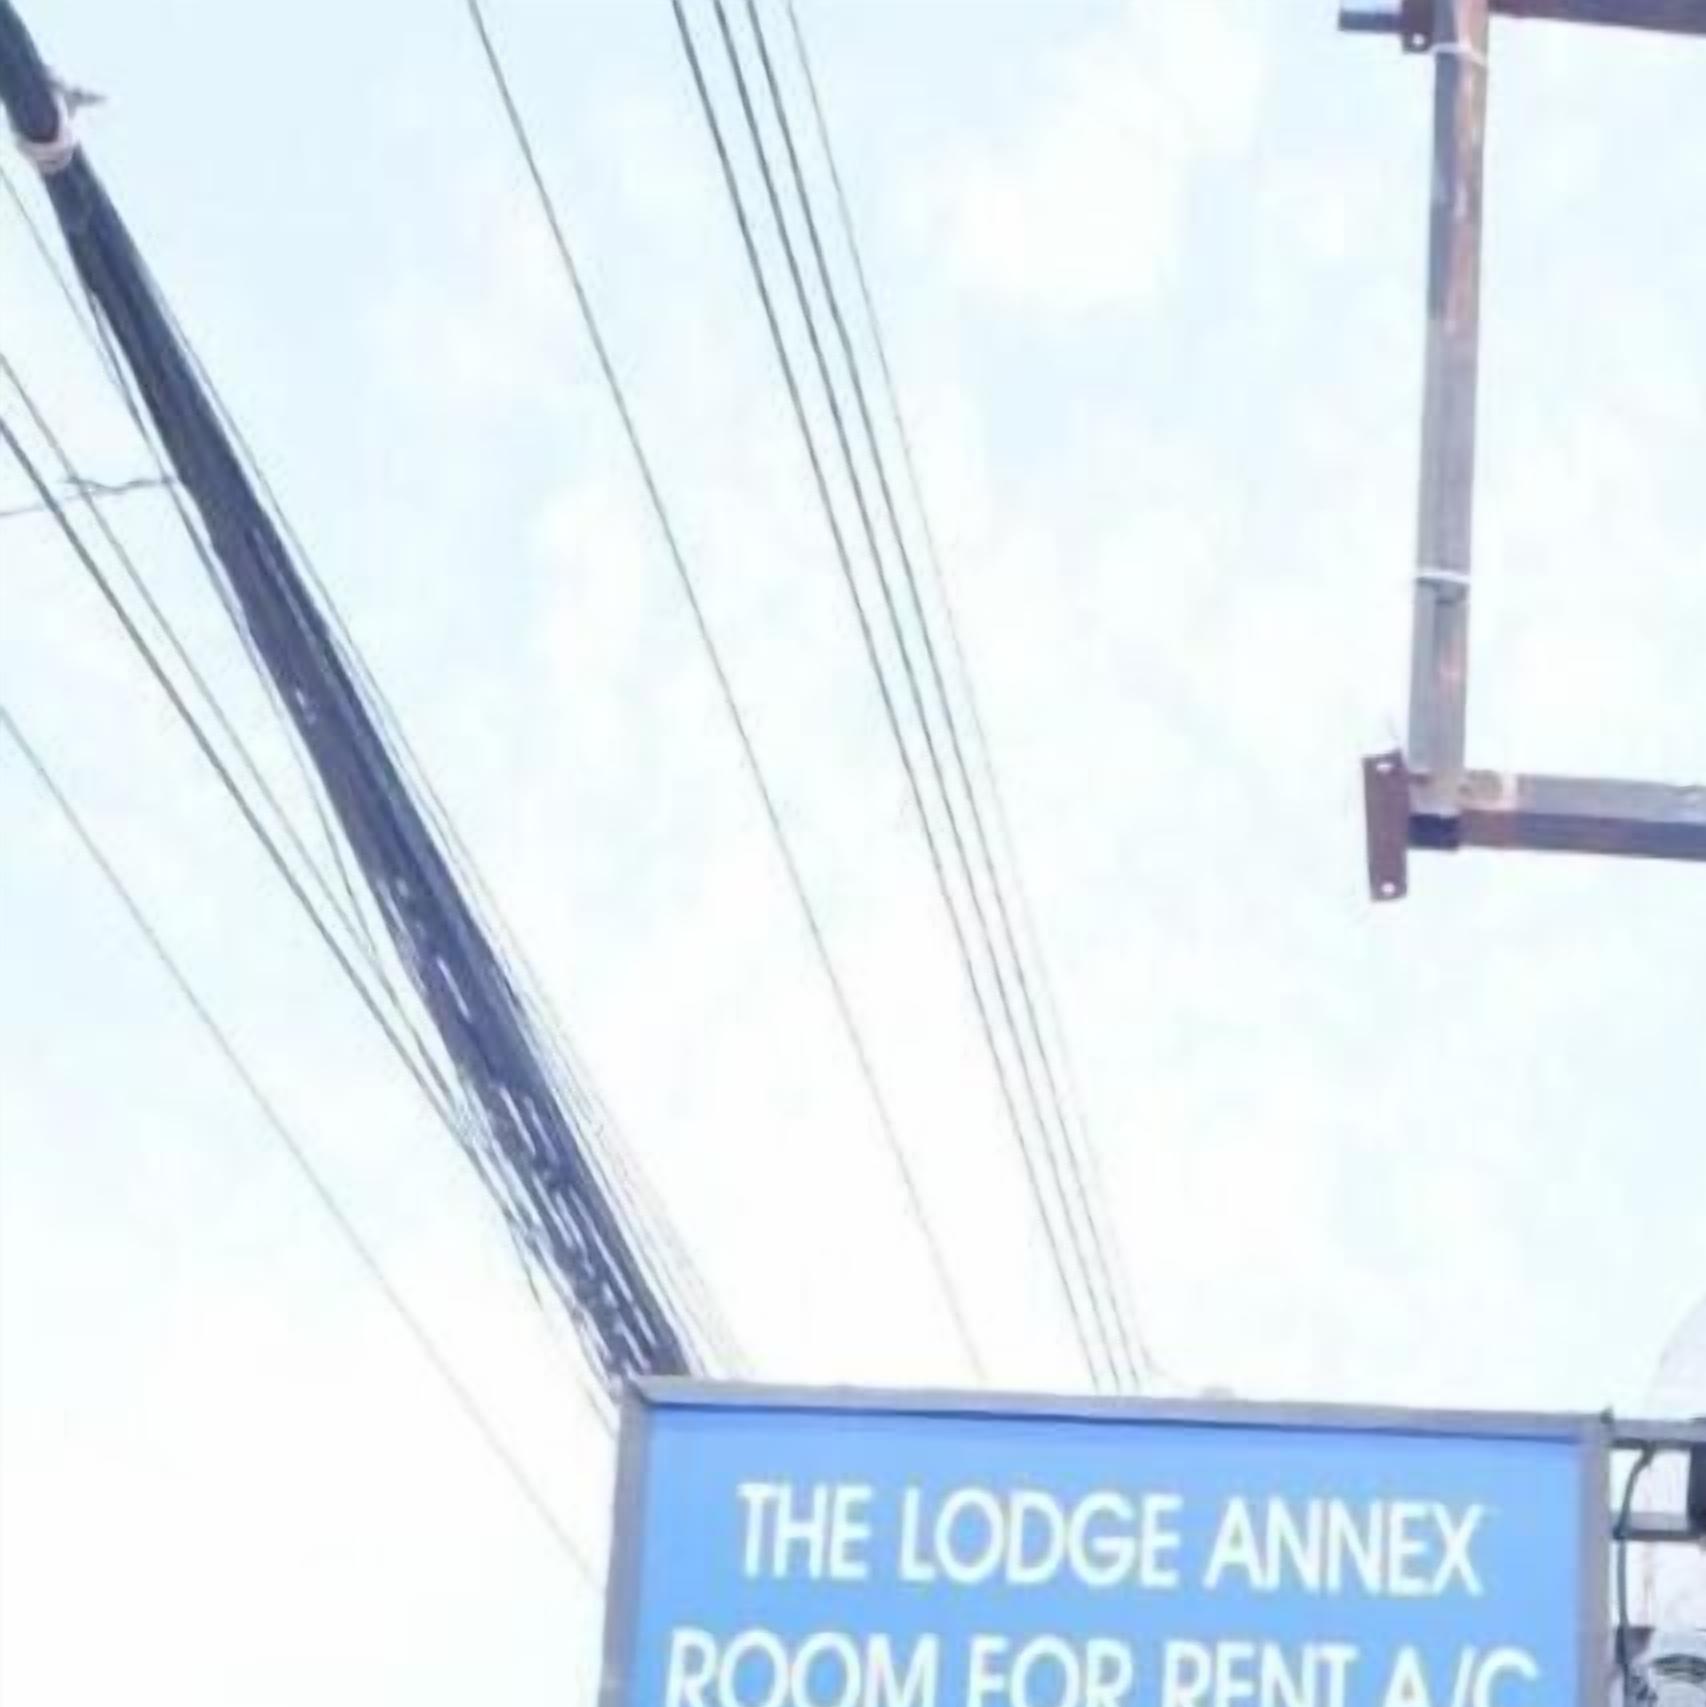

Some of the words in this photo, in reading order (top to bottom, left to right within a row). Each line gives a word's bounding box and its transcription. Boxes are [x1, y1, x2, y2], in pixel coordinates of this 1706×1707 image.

[737, 1480, 874, 1580] THE
[898, 1485, 1184, 1588] LODGE
[1202, 1493, 1486, 1597] ANNEX
